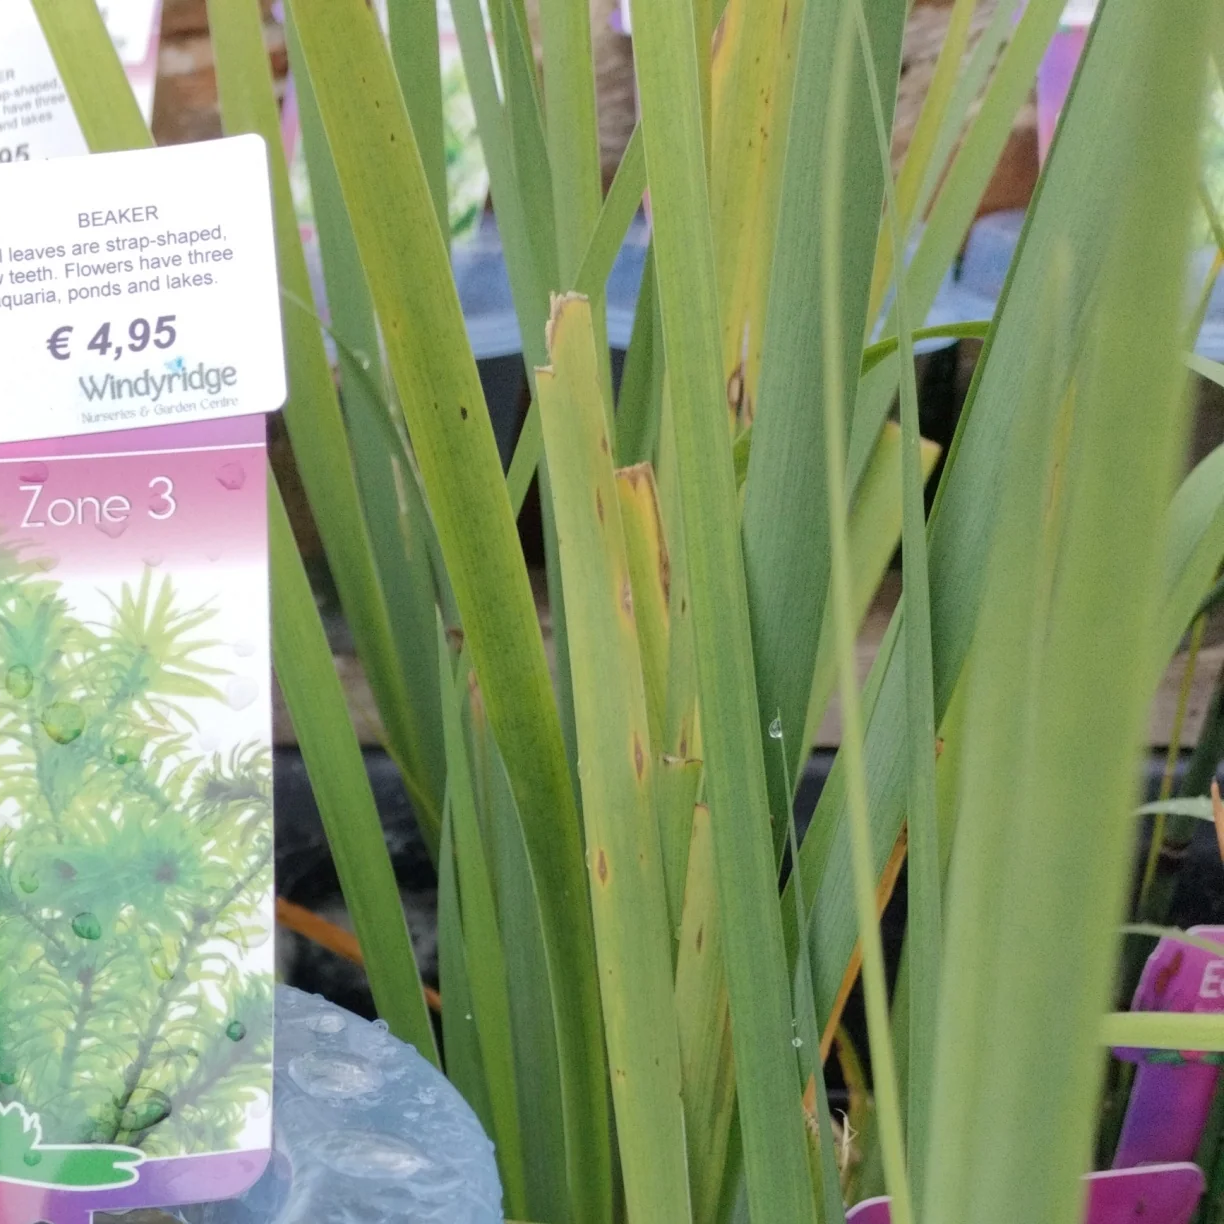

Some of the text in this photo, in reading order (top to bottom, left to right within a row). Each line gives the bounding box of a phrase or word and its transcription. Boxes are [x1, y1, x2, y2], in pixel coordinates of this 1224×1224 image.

[3, 101, 32, 115] have
[77, 204, 160, 229] BEAKER
[8, 243, 66, 263] leaves
[72, 240, 100, 256] are
[106, 224, 227, 252] strap-shaped,
[9, 265, 59, 286] teeth.
[64, 257, 134, 280] Flowers
[139, 252, 182, 271] have
[188, 246, 234, 266] three
[67, 280, 122, 303] ponds
[127, 275, 161, 294] and
[166, 270, 218, 291] lakes.
[46, 313, 178, 362] € 4,95
[78, 360, 238, 402] Windyridge
[81, 406, 136, 425] Nurseries
[153, 401, 197, 417] Garden
[200, 396, 239, 412] Centre
[19, 475, 177, 529] Zone 3
